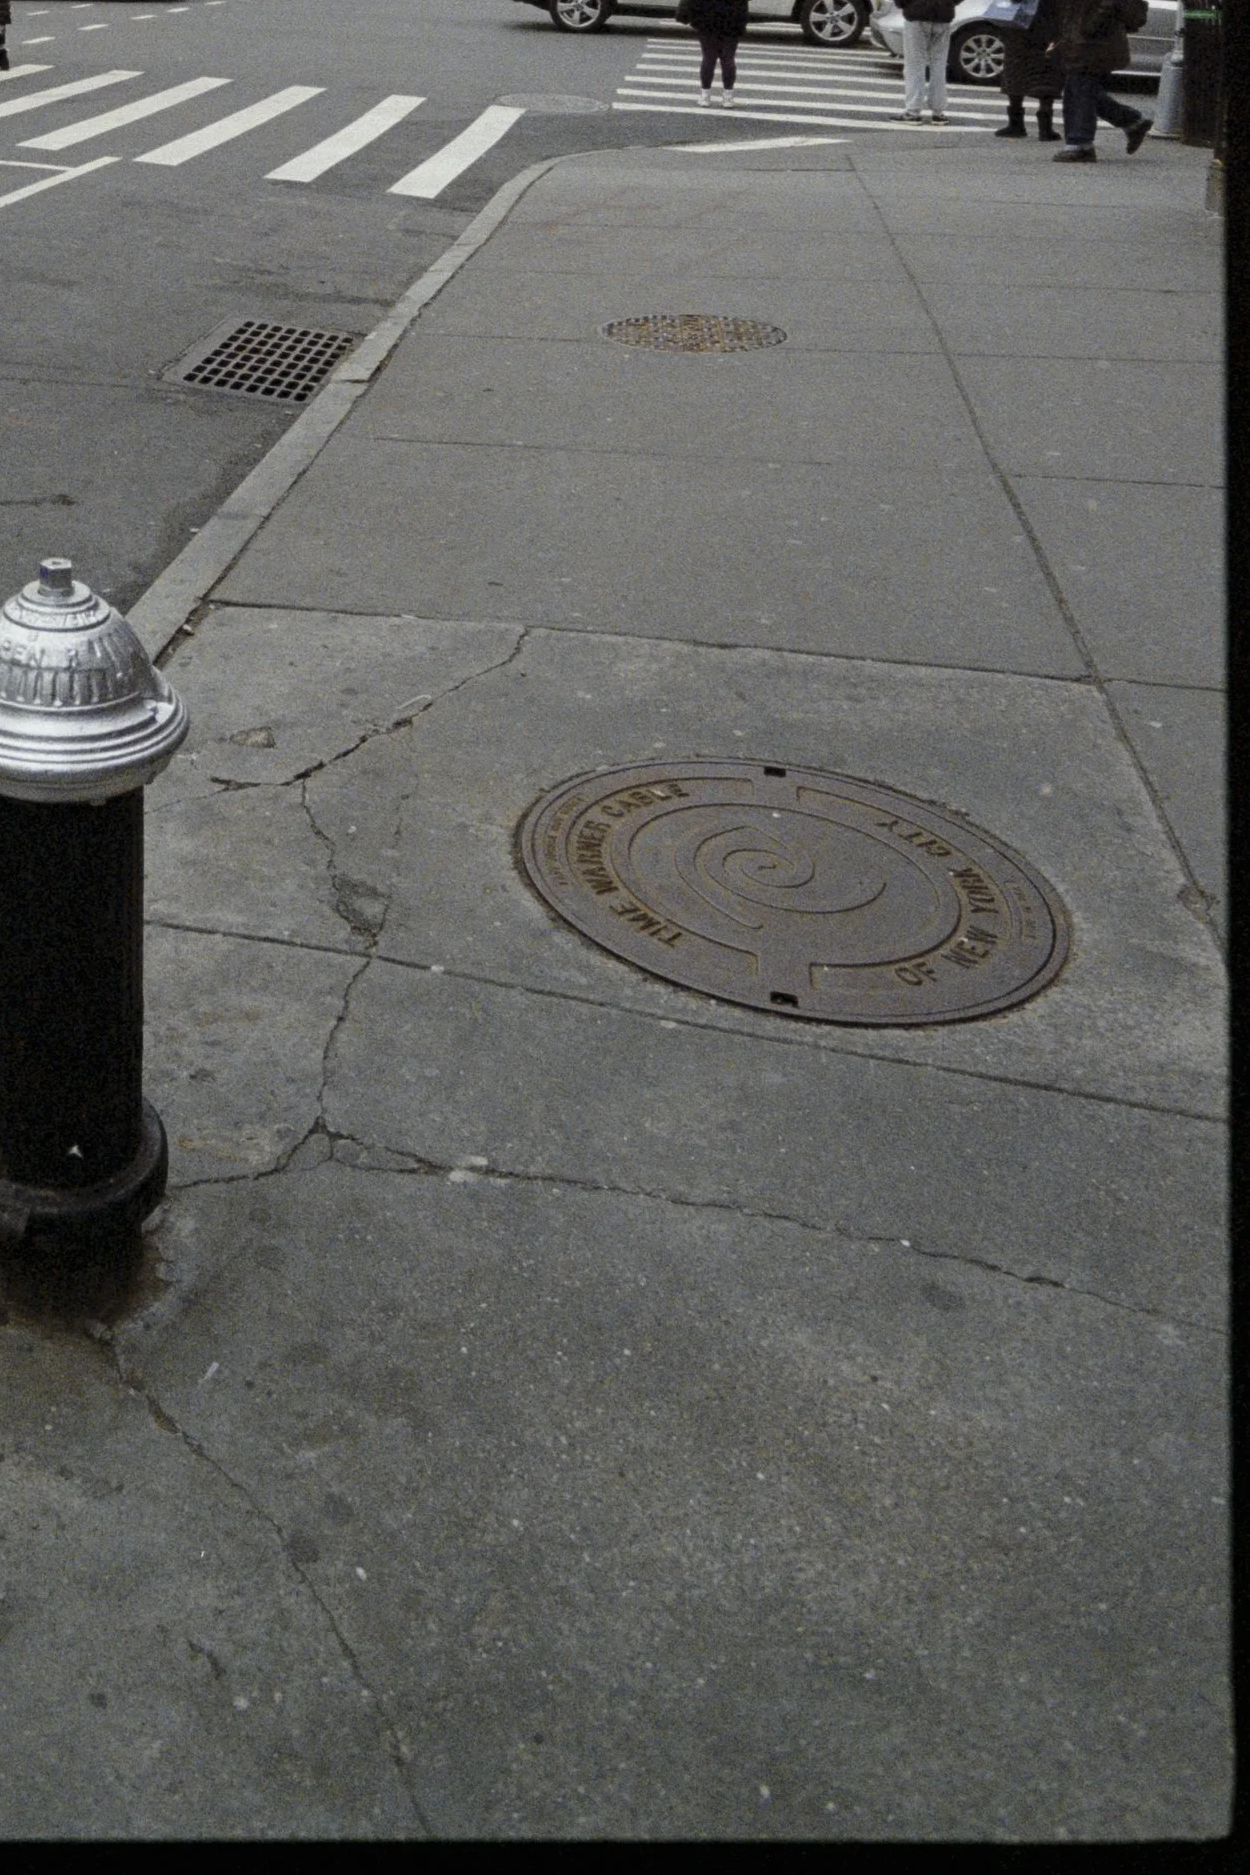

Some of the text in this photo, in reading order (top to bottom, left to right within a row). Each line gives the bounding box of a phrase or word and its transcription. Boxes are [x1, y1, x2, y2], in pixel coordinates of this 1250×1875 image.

[576, 783, 690, 947] TIME WARNER CABLE
[874, 819, 999, 986] OF NEW YORK CITY
